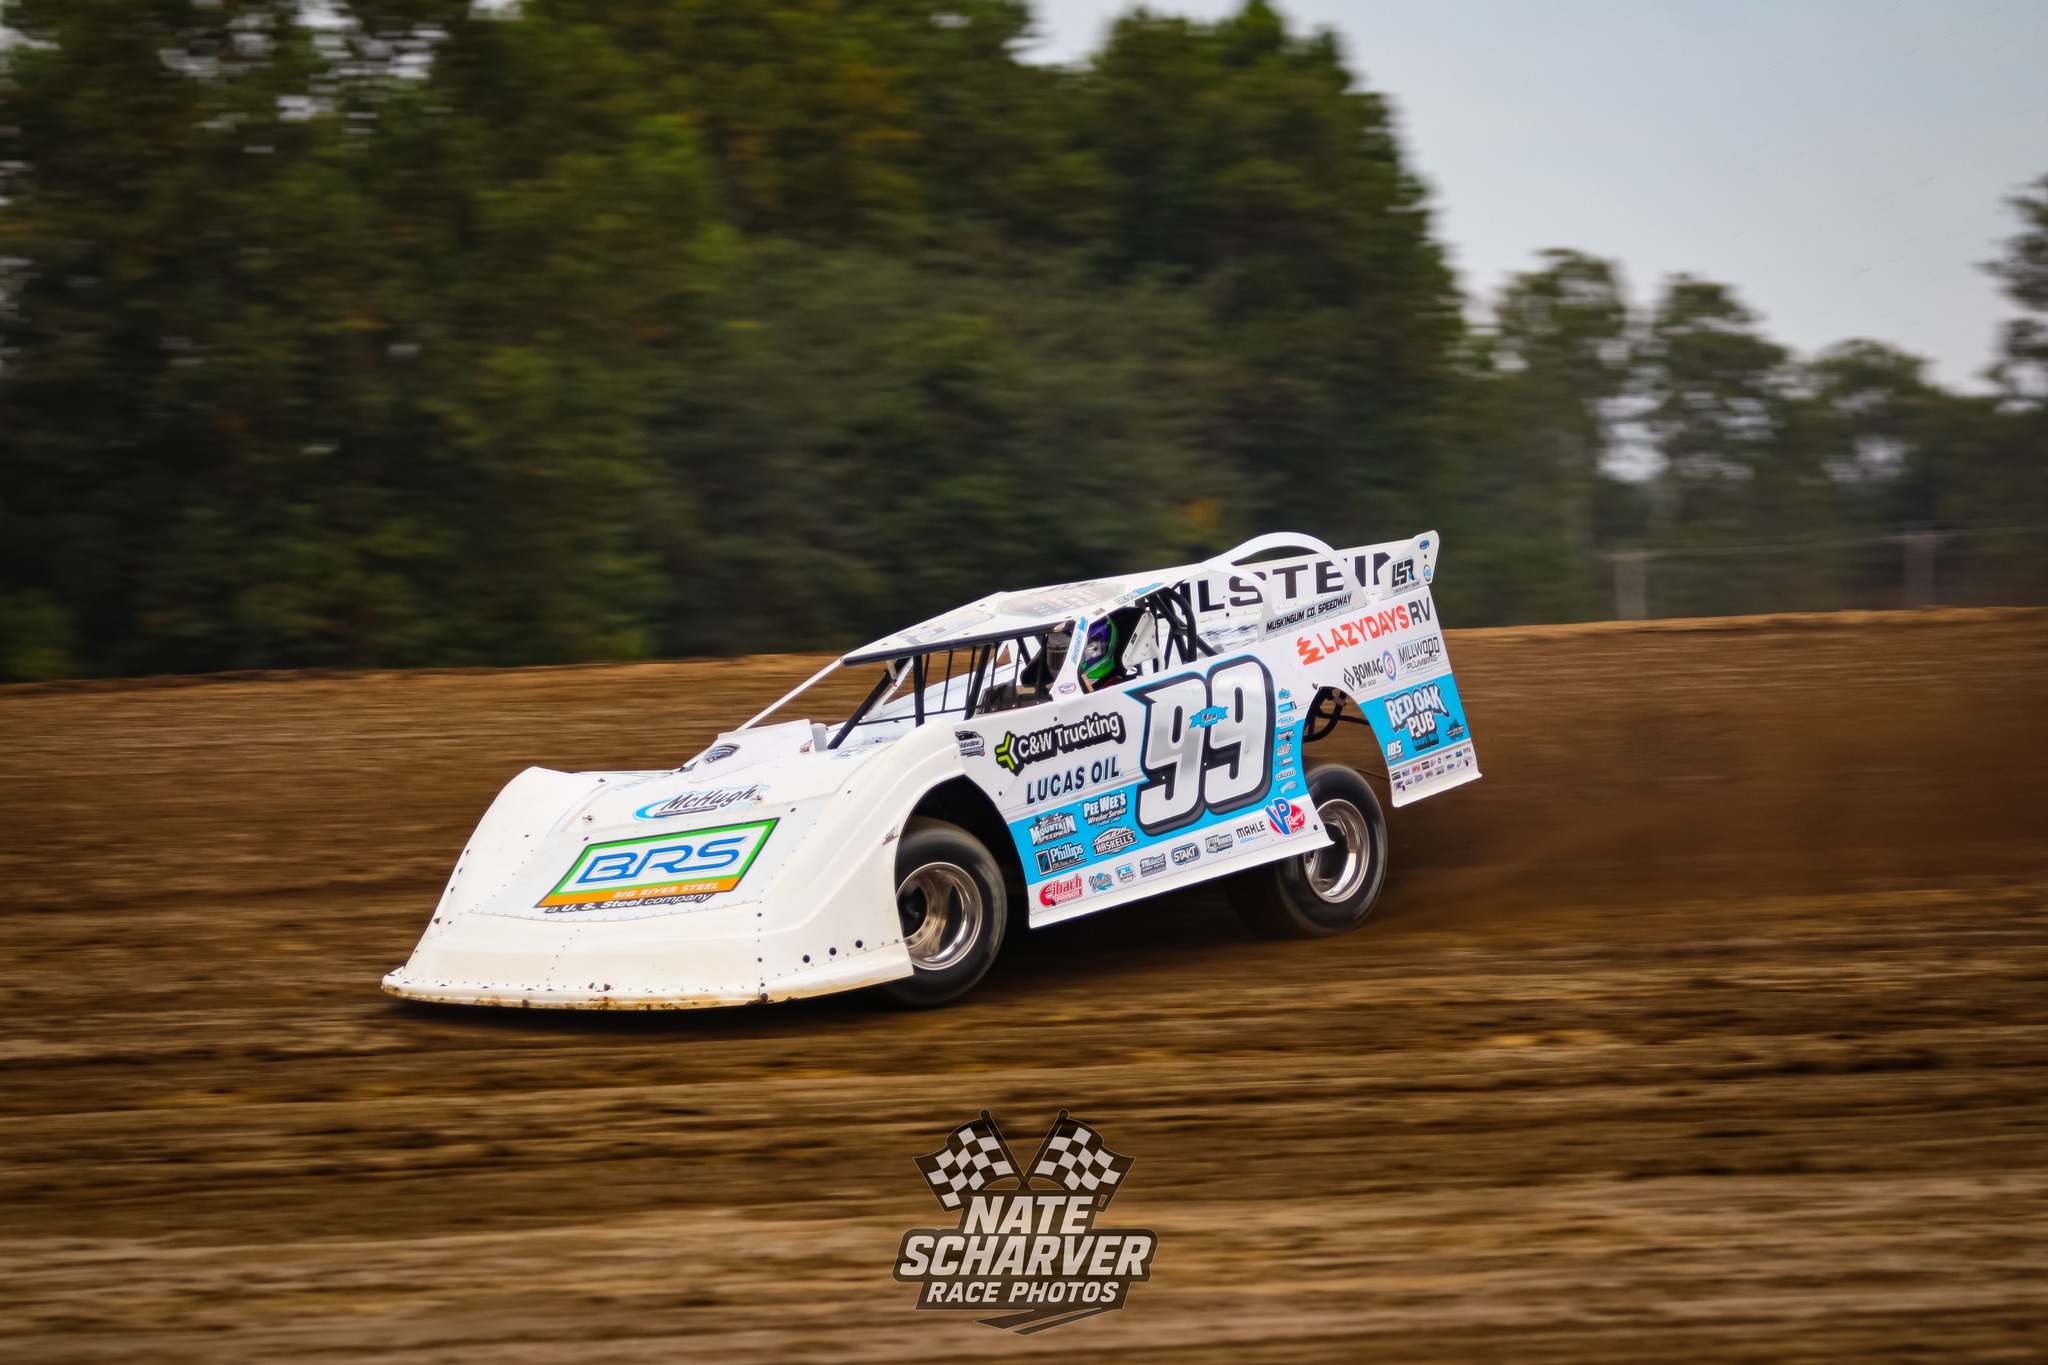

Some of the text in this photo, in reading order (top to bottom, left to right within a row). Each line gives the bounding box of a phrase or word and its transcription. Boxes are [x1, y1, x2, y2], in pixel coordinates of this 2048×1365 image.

[1266, 611, 1304, 632] MUSKINGUM
[1318, 594, 1352, 614] SPEEDWAY
[1316, 597, 1431, 654] LAZYDAYS RV
[1398, 636, 1440, 666] MILLWOOD
[1407, 655, 1438, 670] PLUMBING
[1385, 684, 1448, 728] RED OAK
[1018, 714, 1121, 757] C&W Trucking
[1406, 711, 1436, 737] PUB
[1124, 654, 1276, 836] 99
[1027, 756, 1119, 804] LUCAS OIL
[660, 784, 758, 811] McHugh
[1083, 793, 1127, 818] PEE WEE'S
[1030, 815, 1077, 846] MOUNTAIN
[1236, 821, 1265, 839] MAHLE
[1265, 798, 1291, 835] VP
[1050, 844, 1084, 862] Phillips
[1096, 835, 1135, 854] HASKELLS
[575, 836, 748, 884] BRS
[561, 904, 579, 913] U.
[581, 902, 596, 911] S.
[600, 898, 645, 909] Steel
[645, 893, 713, 906] company
[612, 882, 719, 899] BIG RIVER STEEL
[1040, 874, 1083, 907] Eibach
